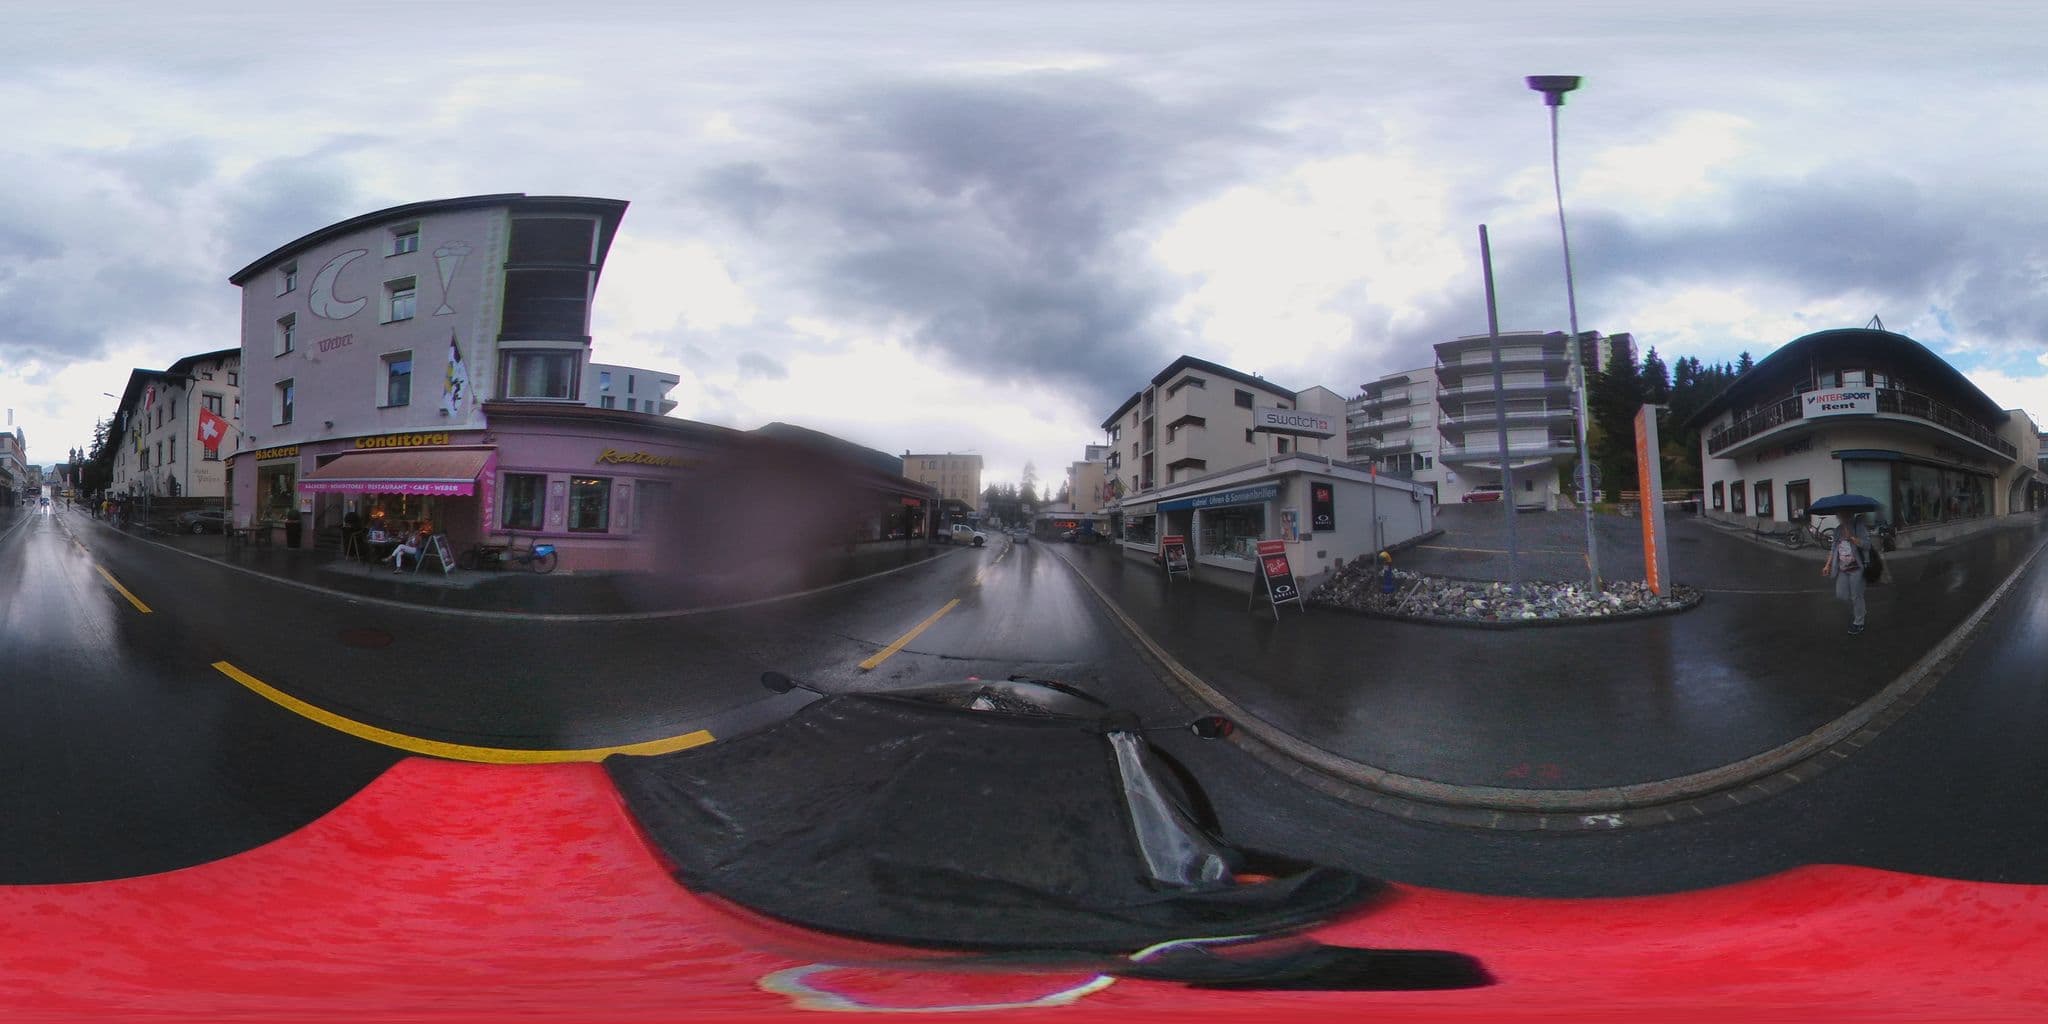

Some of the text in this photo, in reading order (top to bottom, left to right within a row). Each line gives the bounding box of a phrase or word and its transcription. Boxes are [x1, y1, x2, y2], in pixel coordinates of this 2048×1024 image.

[1816, 392, 1871, 404] INTERSPORT
[1821, 402, 1856, 412] Rent
[1266, 413, 1319, 429] swatch
[355, 432, 450, 449] Conditorei
